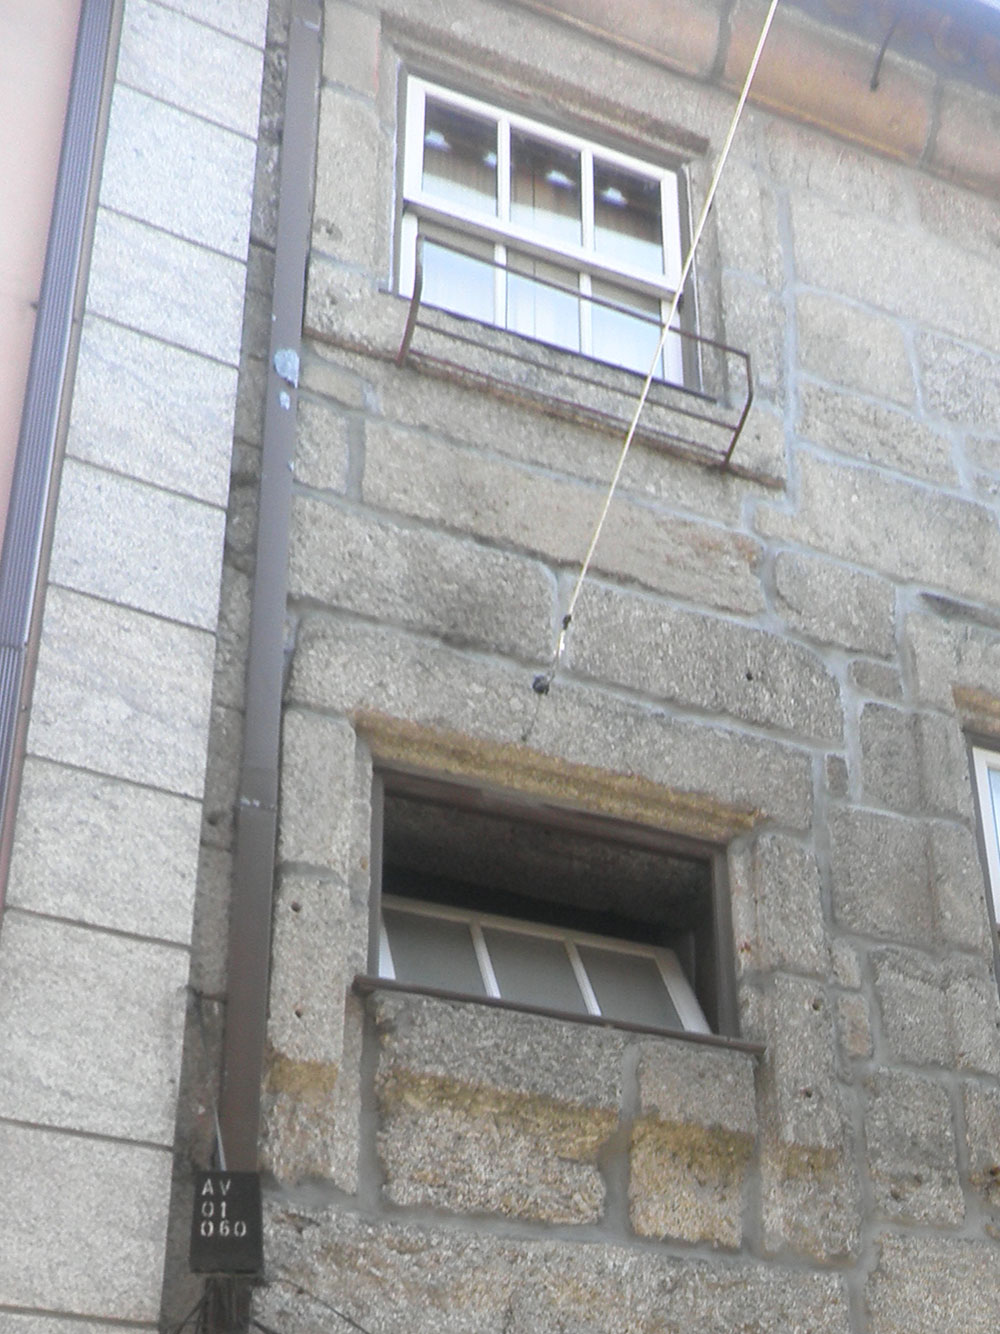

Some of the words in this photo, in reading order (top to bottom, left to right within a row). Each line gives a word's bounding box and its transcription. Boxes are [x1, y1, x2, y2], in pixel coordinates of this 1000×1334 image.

[202, 1178, 231, 1196] AV
[201, 1201, 227, 1218] 01
[201, 1220, 247, 1237] 060
